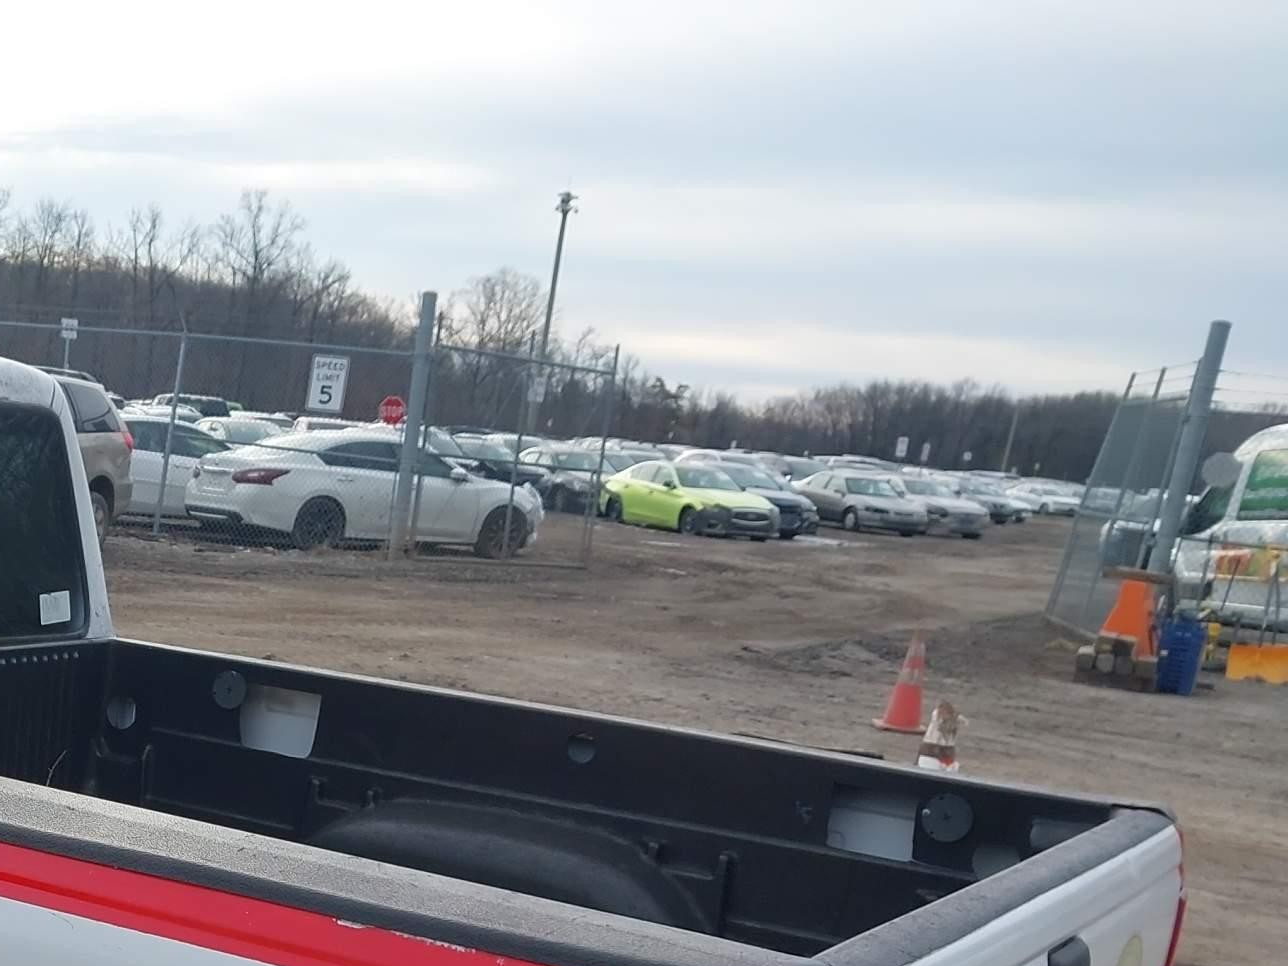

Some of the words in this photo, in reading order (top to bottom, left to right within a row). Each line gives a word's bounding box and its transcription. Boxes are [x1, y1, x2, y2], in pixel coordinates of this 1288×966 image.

[315, 361, 345, 371] SPEED
[316, 373, 340, 382] LIMIT
[318, 385, 332, 404] 5
[381, 406, 403, 418] STOP
